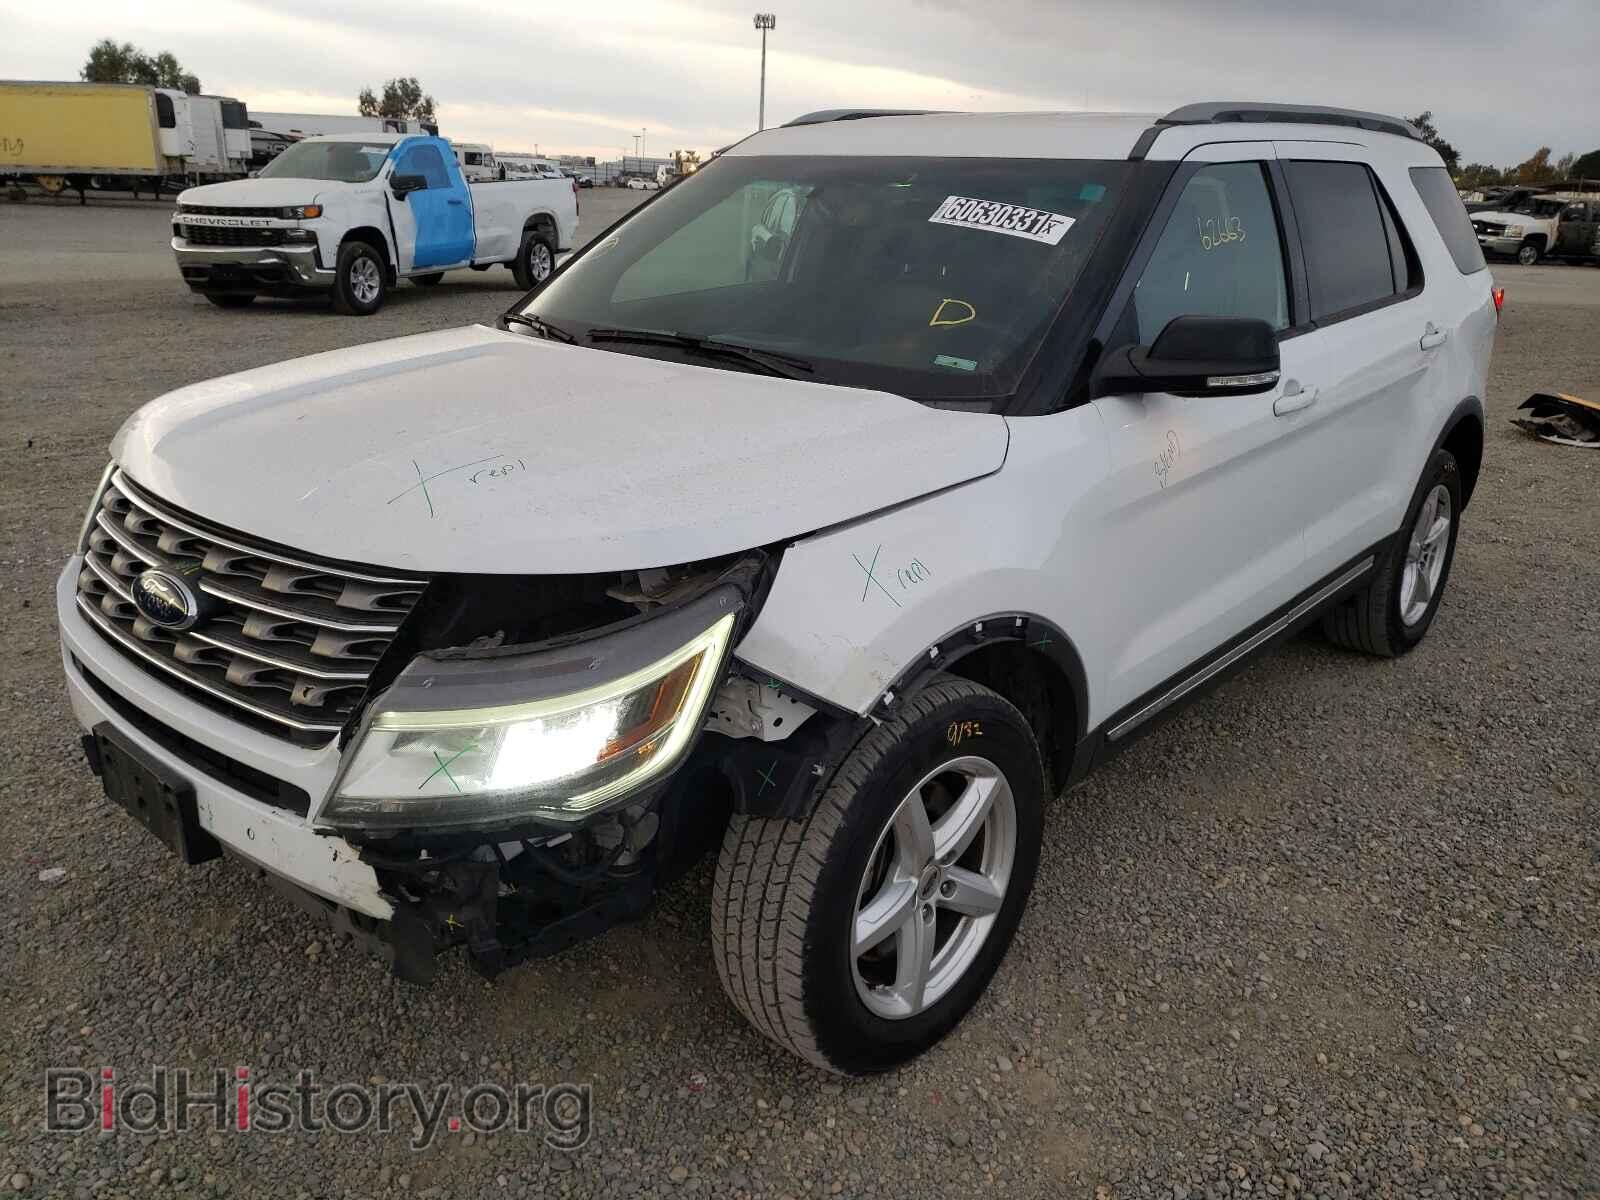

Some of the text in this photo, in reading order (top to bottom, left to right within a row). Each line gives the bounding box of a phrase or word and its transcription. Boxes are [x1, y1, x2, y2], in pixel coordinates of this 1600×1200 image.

[182, 216, 273, 227] CHEVROLET
[942, 197, 1049, 236] 60630331
[928, 298, 976, 327] D
